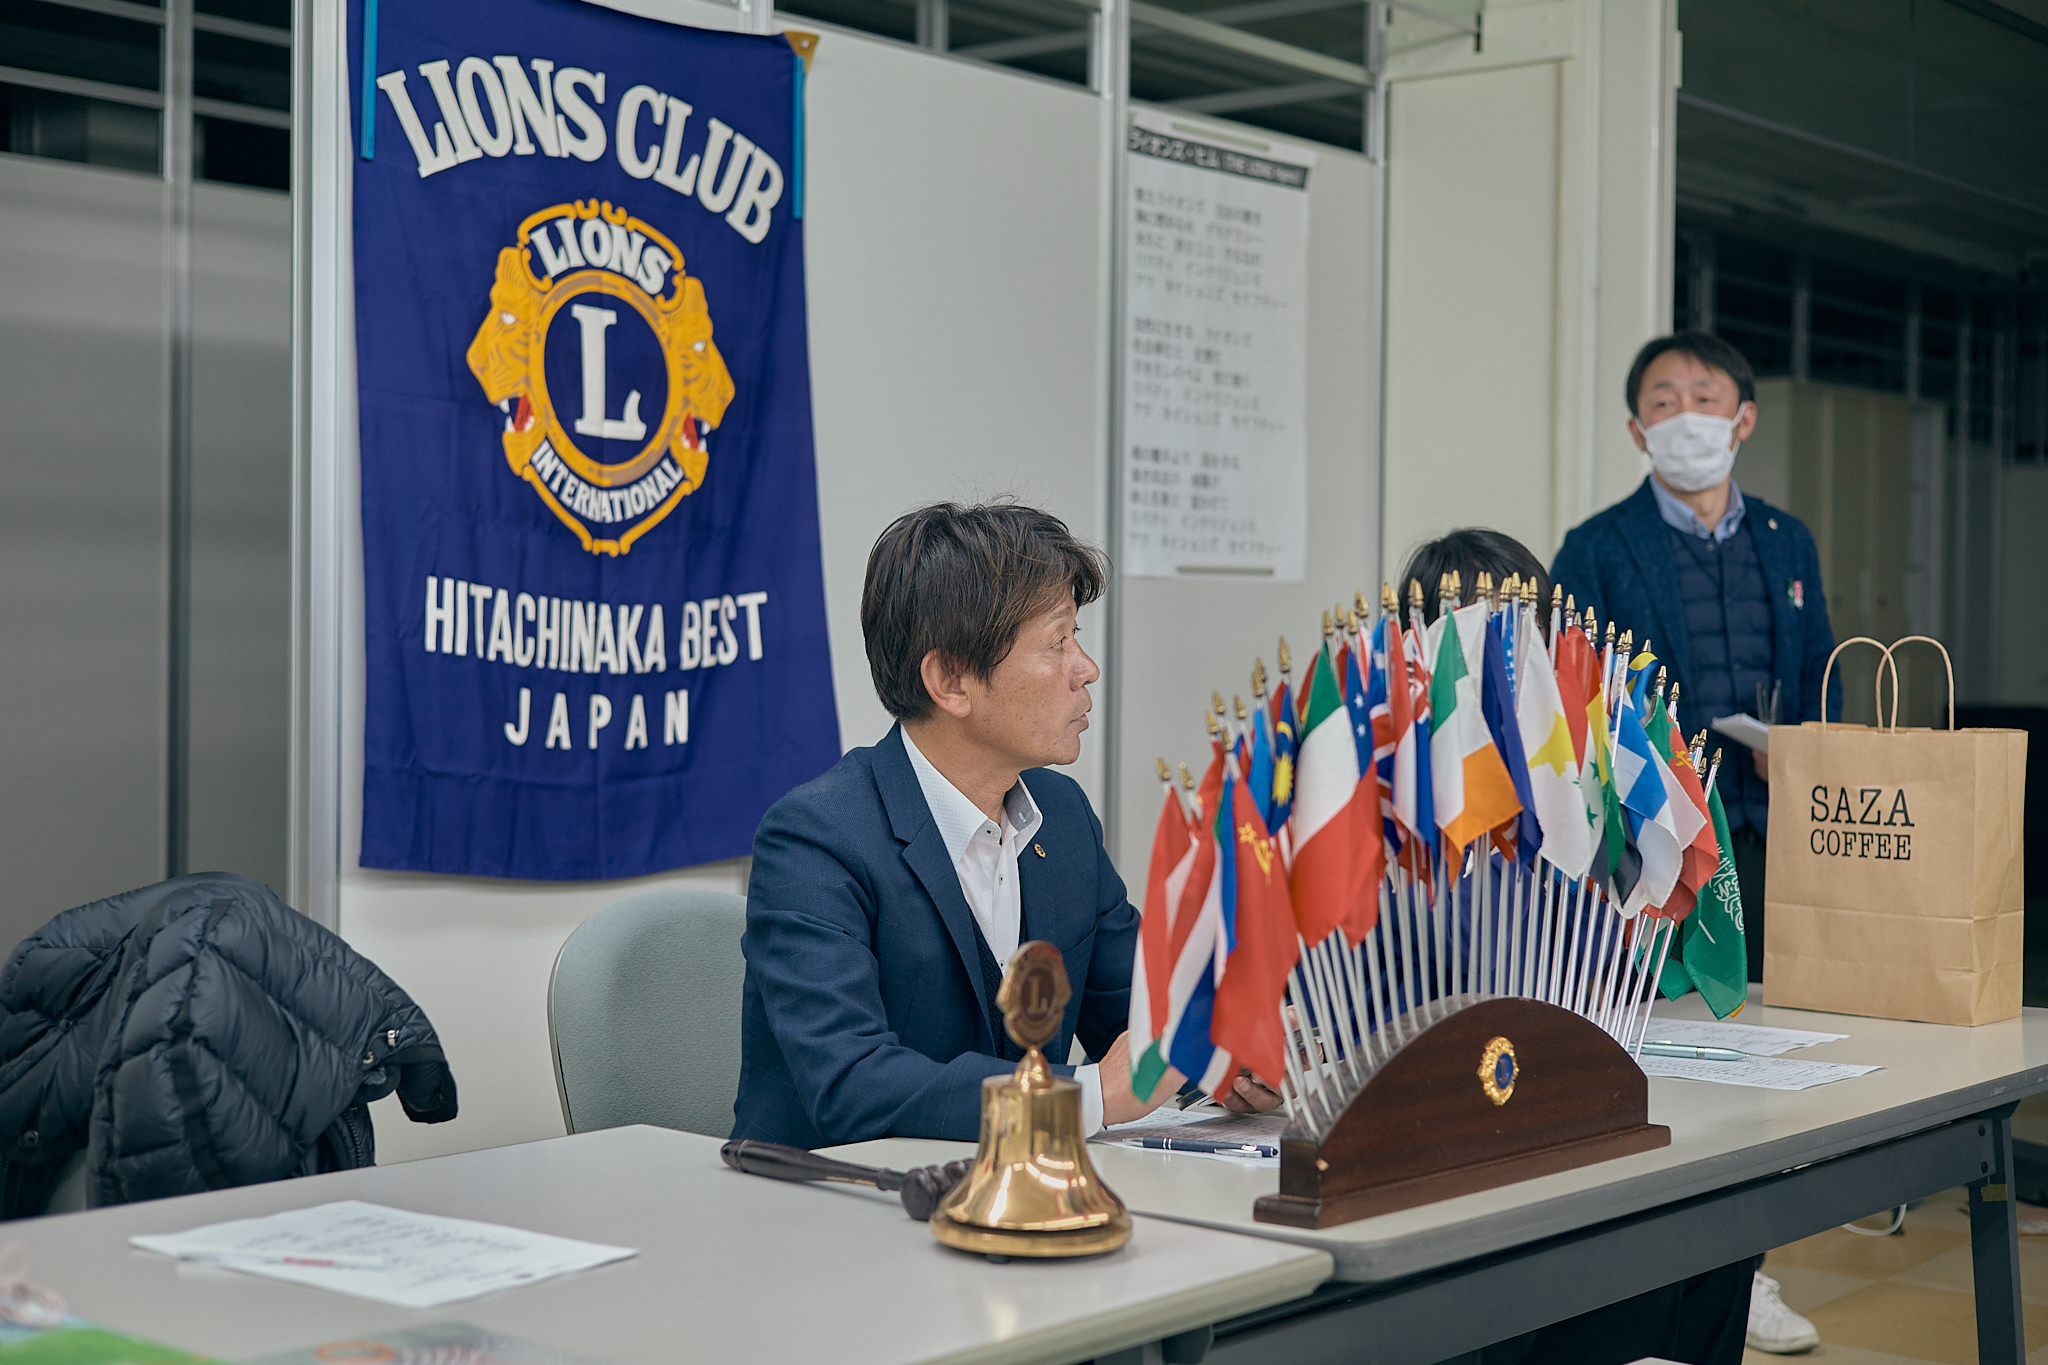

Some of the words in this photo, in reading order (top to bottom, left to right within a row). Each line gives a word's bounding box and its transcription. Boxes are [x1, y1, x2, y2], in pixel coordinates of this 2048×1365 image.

[376, 55, 607, 179] LIONS
[615, 84, 784, 244] CLUB
[530, 218, 673, 295] LIONS
[571, 303, 647, 441] L
[531, 441, 684, 523] INTERNATIONAL
[424, 575, 666, 674] HITACHINAKA
[679, 591, 768, 671] BEST
[503, 687, 689, 750] JAPAN
[1810, 829, 1911, 860] COFFEE
[1811, 785, 1915, 827] SAZA
